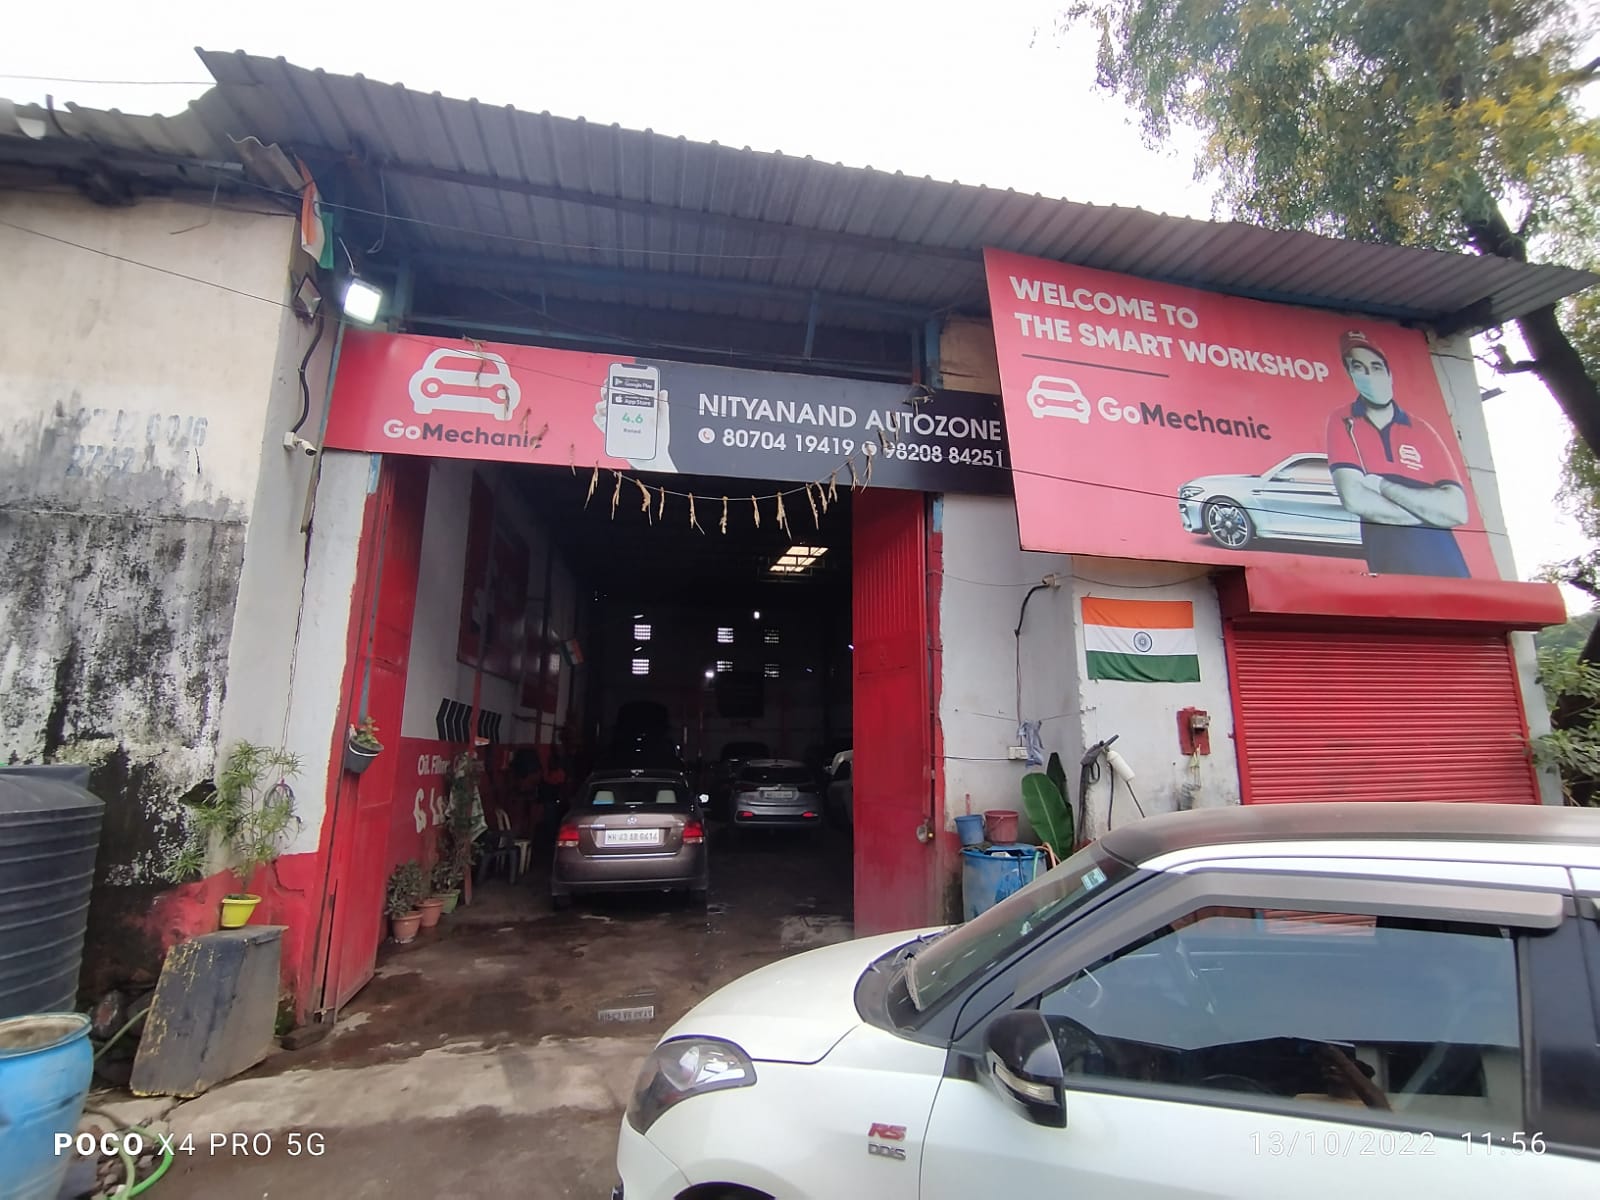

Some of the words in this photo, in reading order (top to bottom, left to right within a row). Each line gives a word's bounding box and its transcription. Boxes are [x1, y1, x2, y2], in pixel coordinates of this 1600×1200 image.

[1009, 276, 1157, 322] WELCOME
[1160, 303, 1198, 329] TO
[1014, 312, 1072, 343] THE
[1079, 323, 1173, 358] SMART
[1177, 339, 1329, 382] WORKSHOP
[622, 412, 644, 424] 4.6
[699, 393, 857, 428] NITYANAND
[865, 409, 1001, 441] AUTOZONE
[1097, 396, 1272, 440] GoMechanic
[722, 428, 787, 450] 80704
[795, 434, 855, 456] 19419
[883, 442, 942, 463] 98208
[949, 446, 1003, 468] 84251
[868, 1122, 907, 1141] RS
